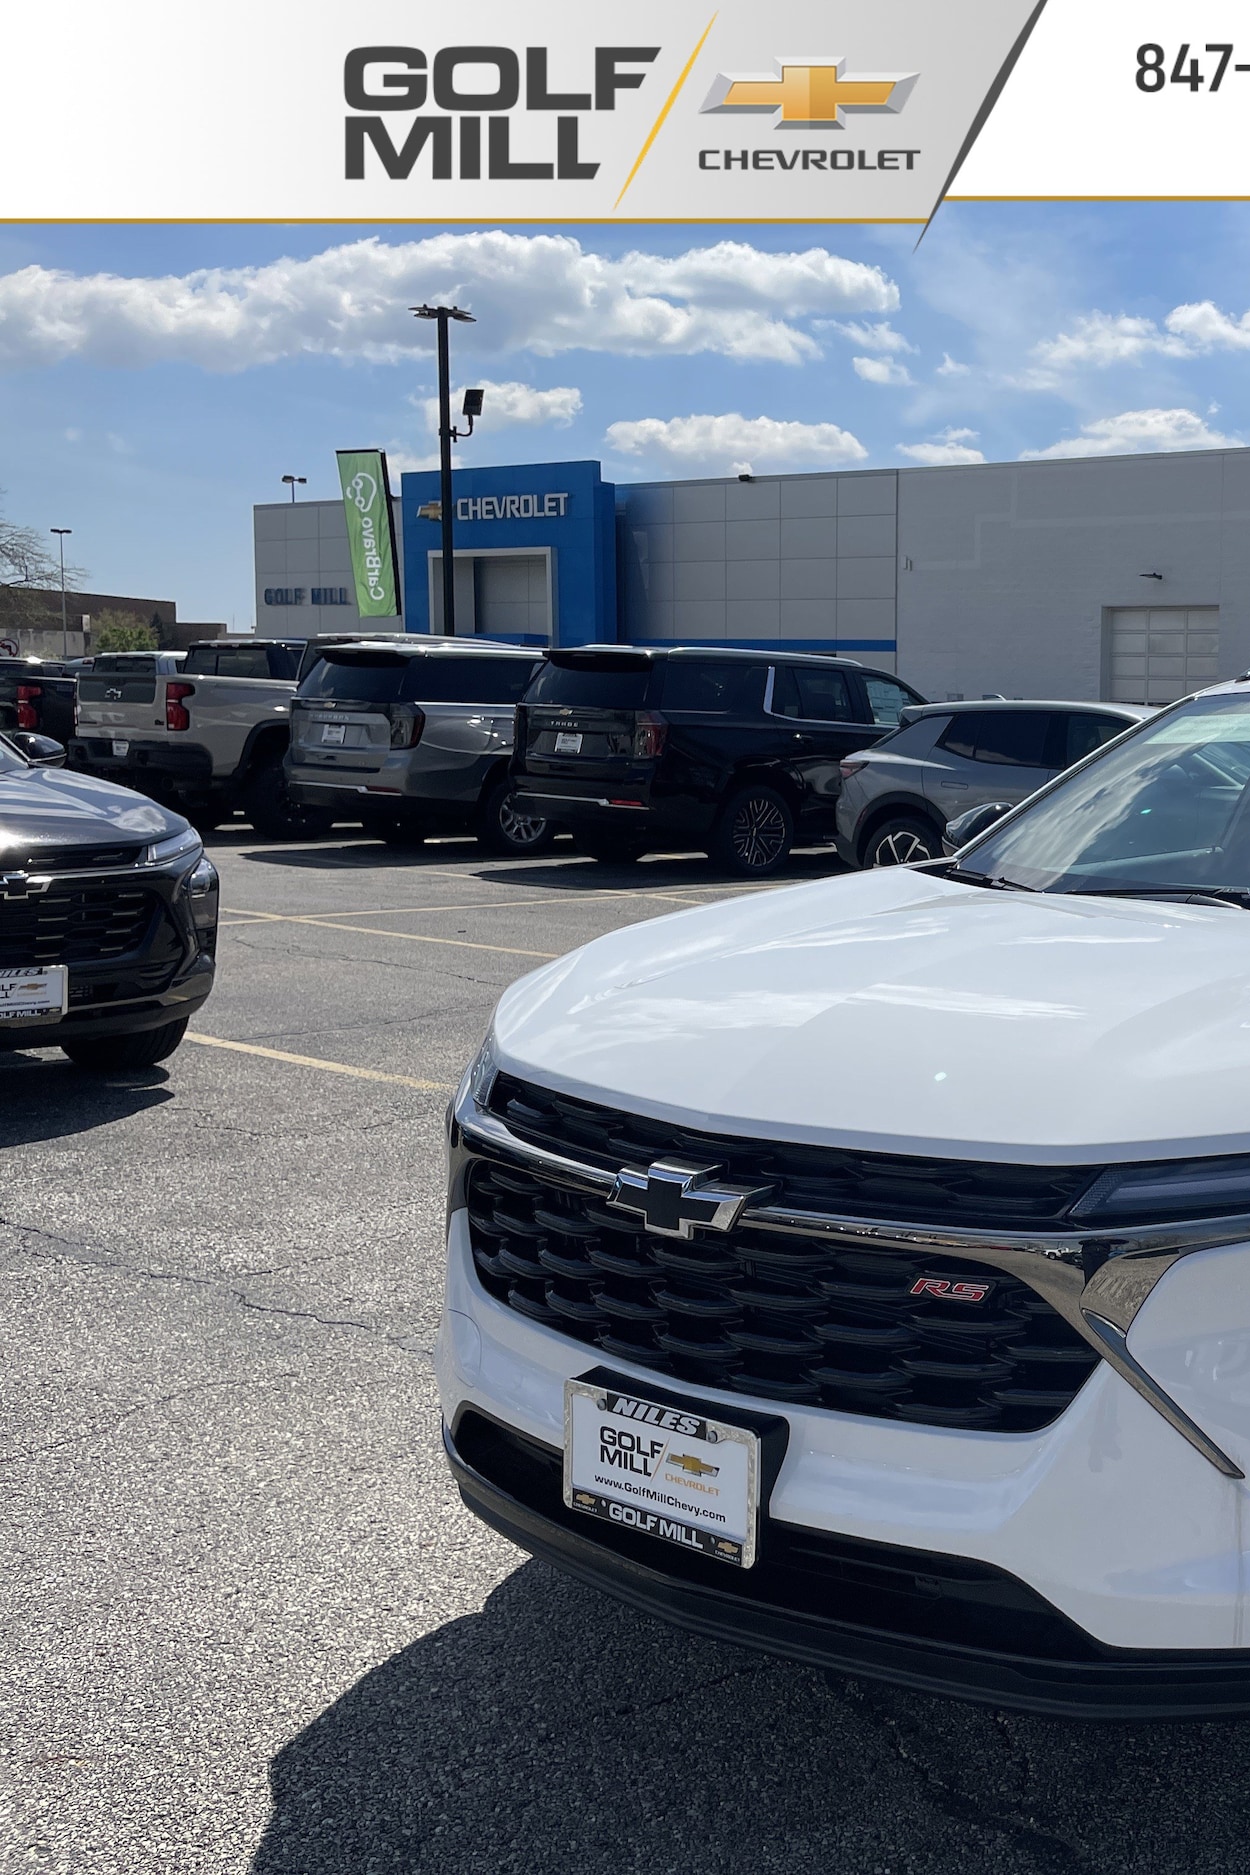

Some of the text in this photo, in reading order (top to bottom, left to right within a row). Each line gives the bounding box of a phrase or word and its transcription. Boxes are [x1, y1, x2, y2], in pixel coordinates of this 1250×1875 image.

[457, 493, 568, 520] CHEVROLET
[265, 587, 352, 605] GOLF MILL
[16, 1009, 41, 1018] MILL
[910, 1278, 989, 1301] RS
[613, 1398, 700, 1435] NILES
[600, 1426, 663, 1459] GOLF
[600, 1445, 652, 1477] MILL
[594, 1474, 726, 1522] www.GolfMillChevy.com
[665, 1473, 719, 1496] CHEVROLET
[609, 1502, 703, 1549] GOLF MILL
